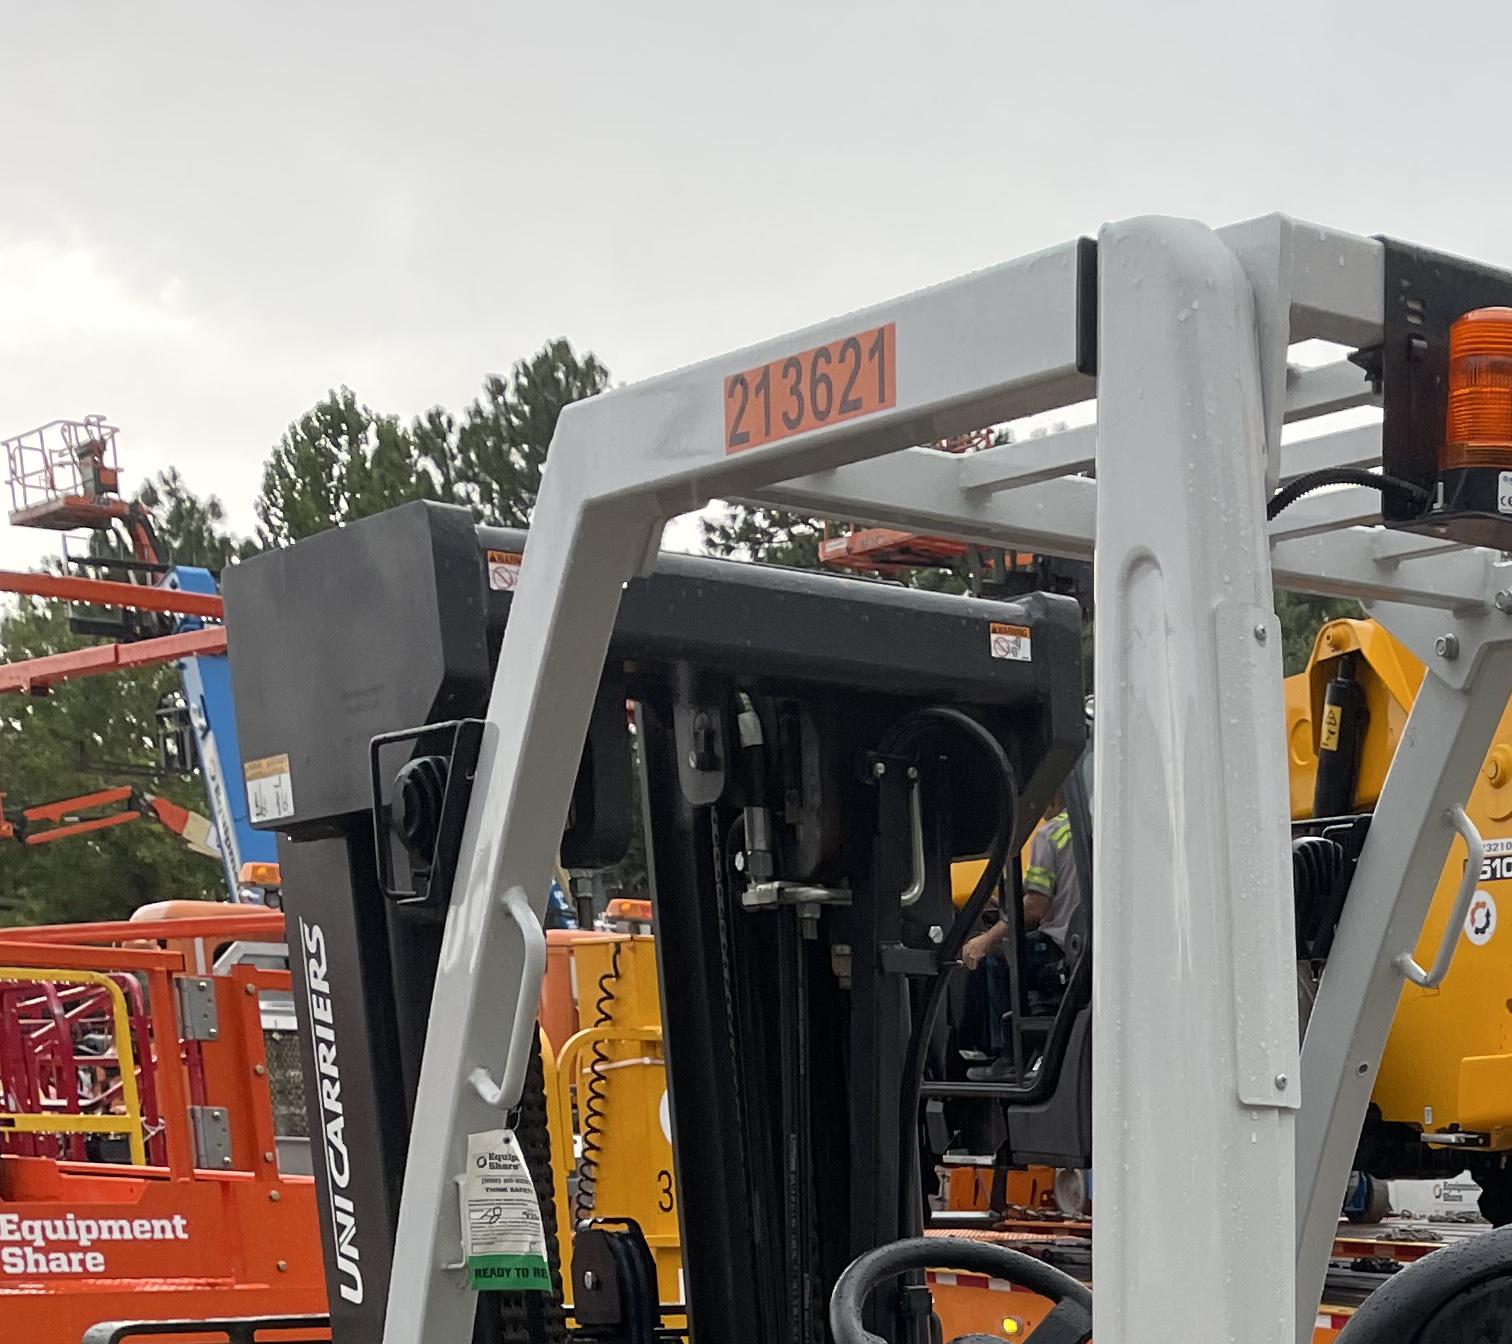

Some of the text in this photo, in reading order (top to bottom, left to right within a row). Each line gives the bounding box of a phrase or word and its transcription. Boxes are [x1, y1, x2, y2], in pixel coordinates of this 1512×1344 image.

[727, 325, 886, 448] 213621
[0, 1213, 189, 1247] Equipment
[1, 1246, 106, 1274] Share
[474, 1266, 511, 1279] READY
[514, 1267, 530, 1279] TO
